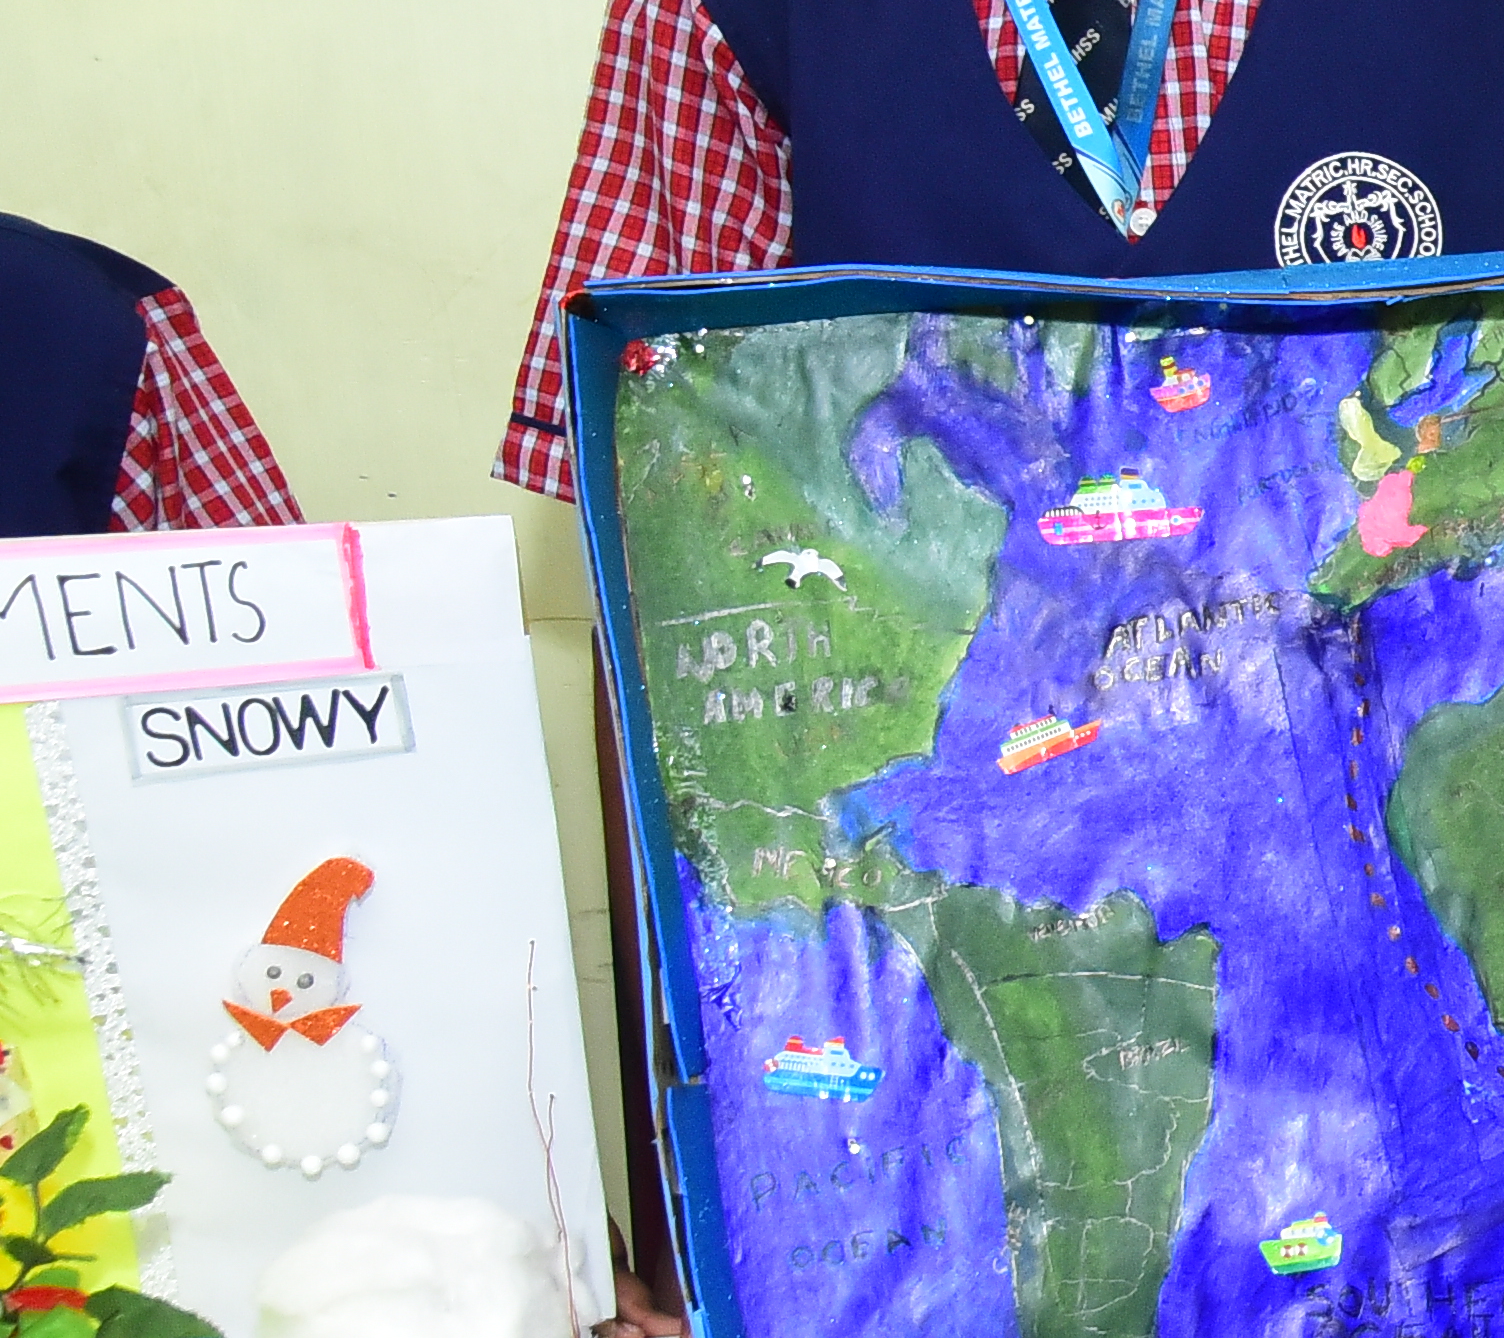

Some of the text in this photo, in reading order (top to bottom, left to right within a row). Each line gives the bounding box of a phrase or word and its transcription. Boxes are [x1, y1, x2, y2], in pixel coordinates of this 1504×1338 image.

[1047, 51, 1094, 138] BETHEL
[1126, 31, 1158, 123] BETHEL
[139, 684, 390, 768] SNOWY
